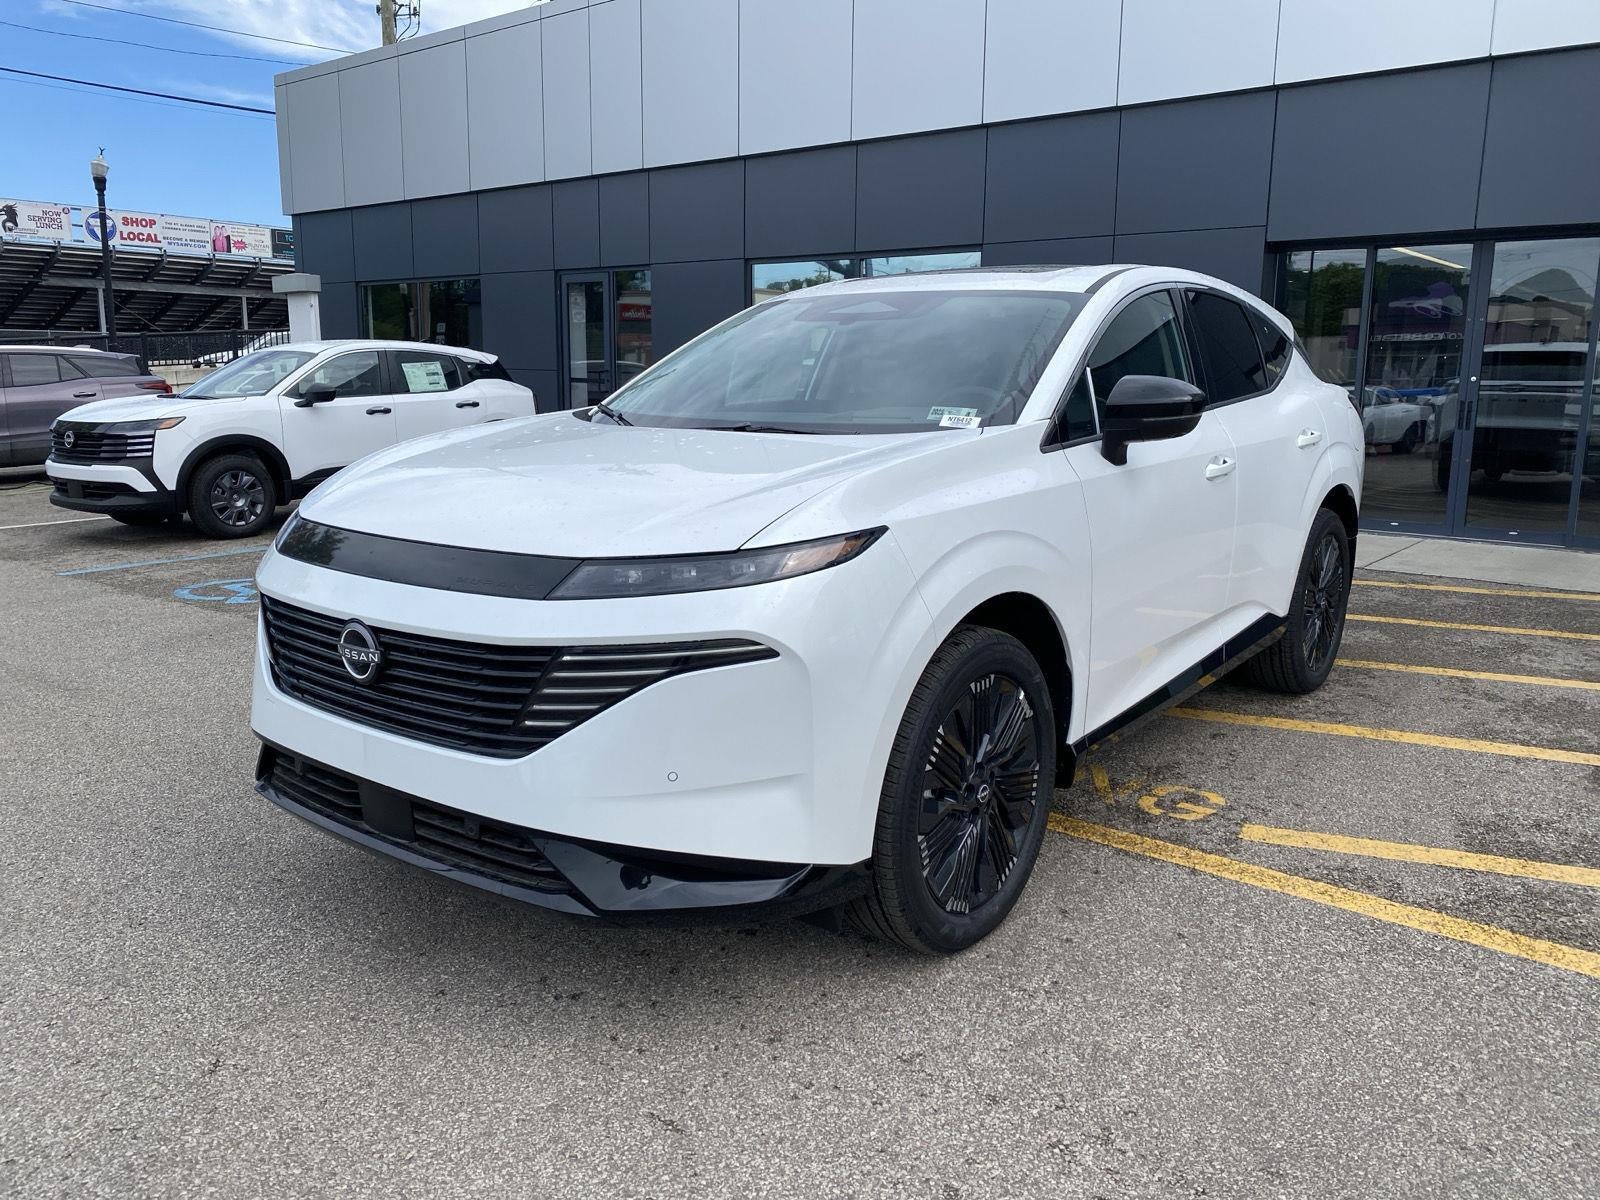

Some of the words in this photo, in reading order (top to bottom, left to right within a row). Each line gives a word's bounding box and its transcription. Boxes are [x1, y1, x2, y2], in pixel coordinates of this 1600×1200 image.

[41, 209, 62, 218] NOW
[27, 214, 62, 224] SERVING
[121, 216, 157, 229] SHOP
[35, 222, 63, 230] LUNCH
[119, 230, 161, 244] LOCAL
